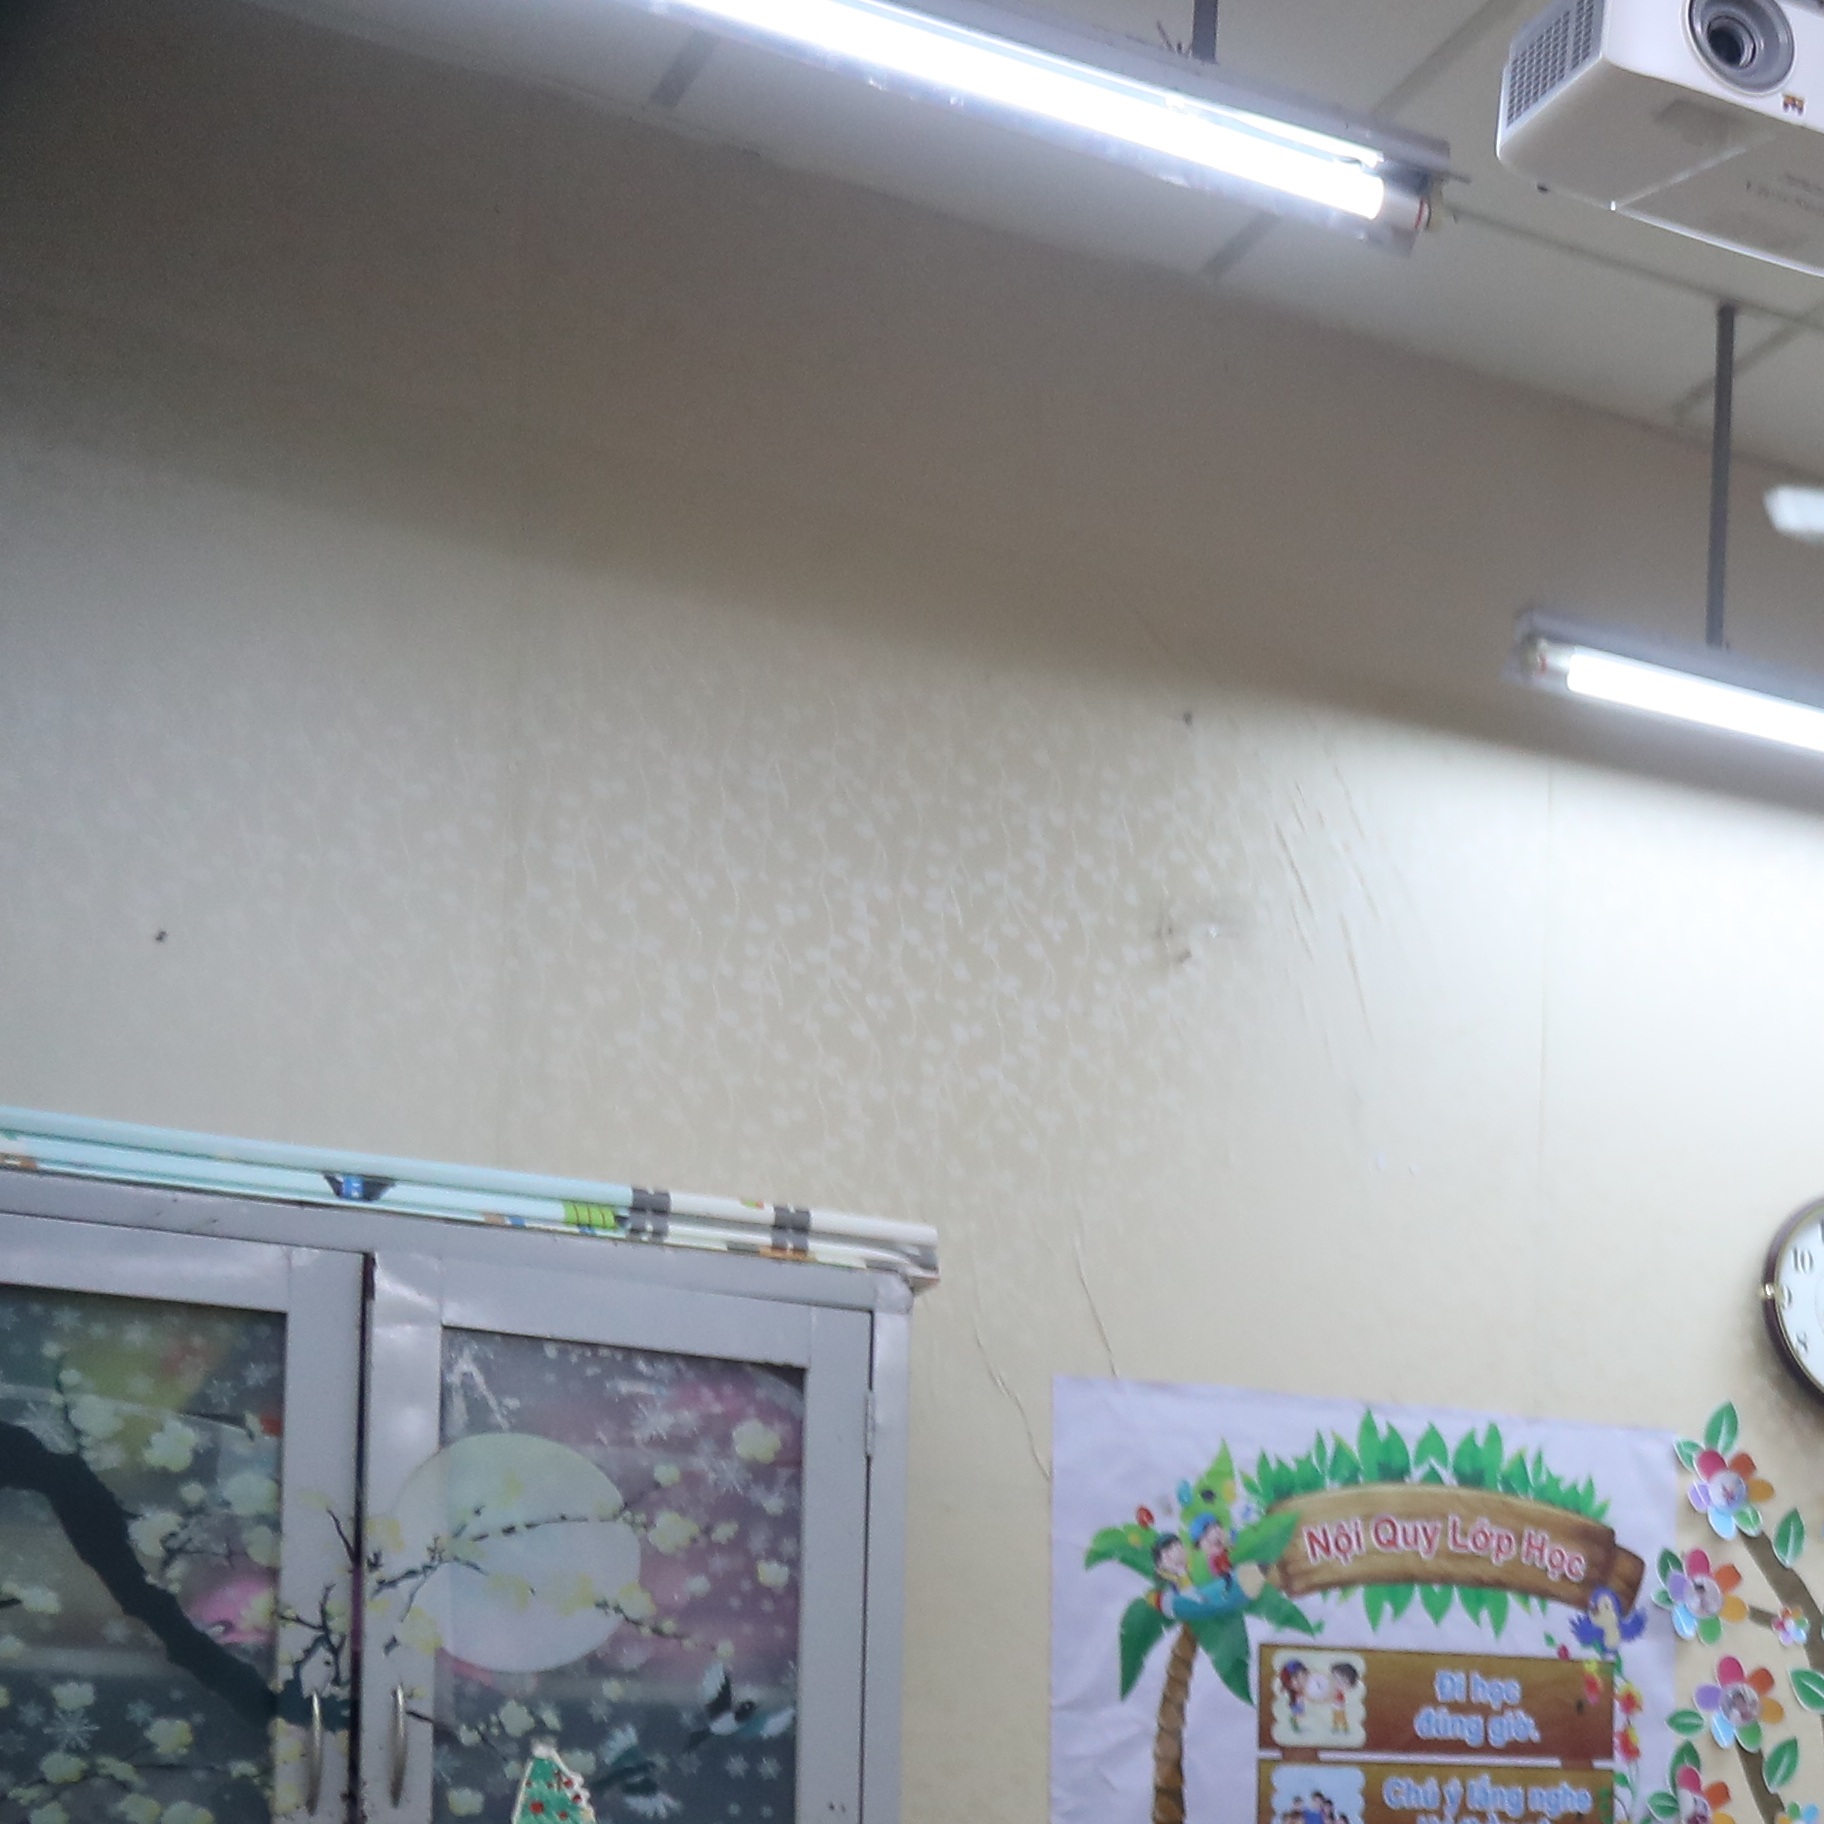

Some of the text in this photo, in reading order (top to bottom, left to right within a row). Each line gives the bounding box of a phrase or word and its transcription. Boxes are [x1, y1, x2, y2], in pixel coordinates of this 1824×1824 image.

[1793, 1247, 1814, 1274] 10
[1780, 1284, 1792, 1310] 9
[1304, 1513, 1586, 1581] Nội Quy Lớp Học
[1435, 1668, 1521, 1710] Đi học
[1413, 1706, 1485, 1747] đúng
[1382, 1773, 1593, 1819] Chú ý lắng nghe
